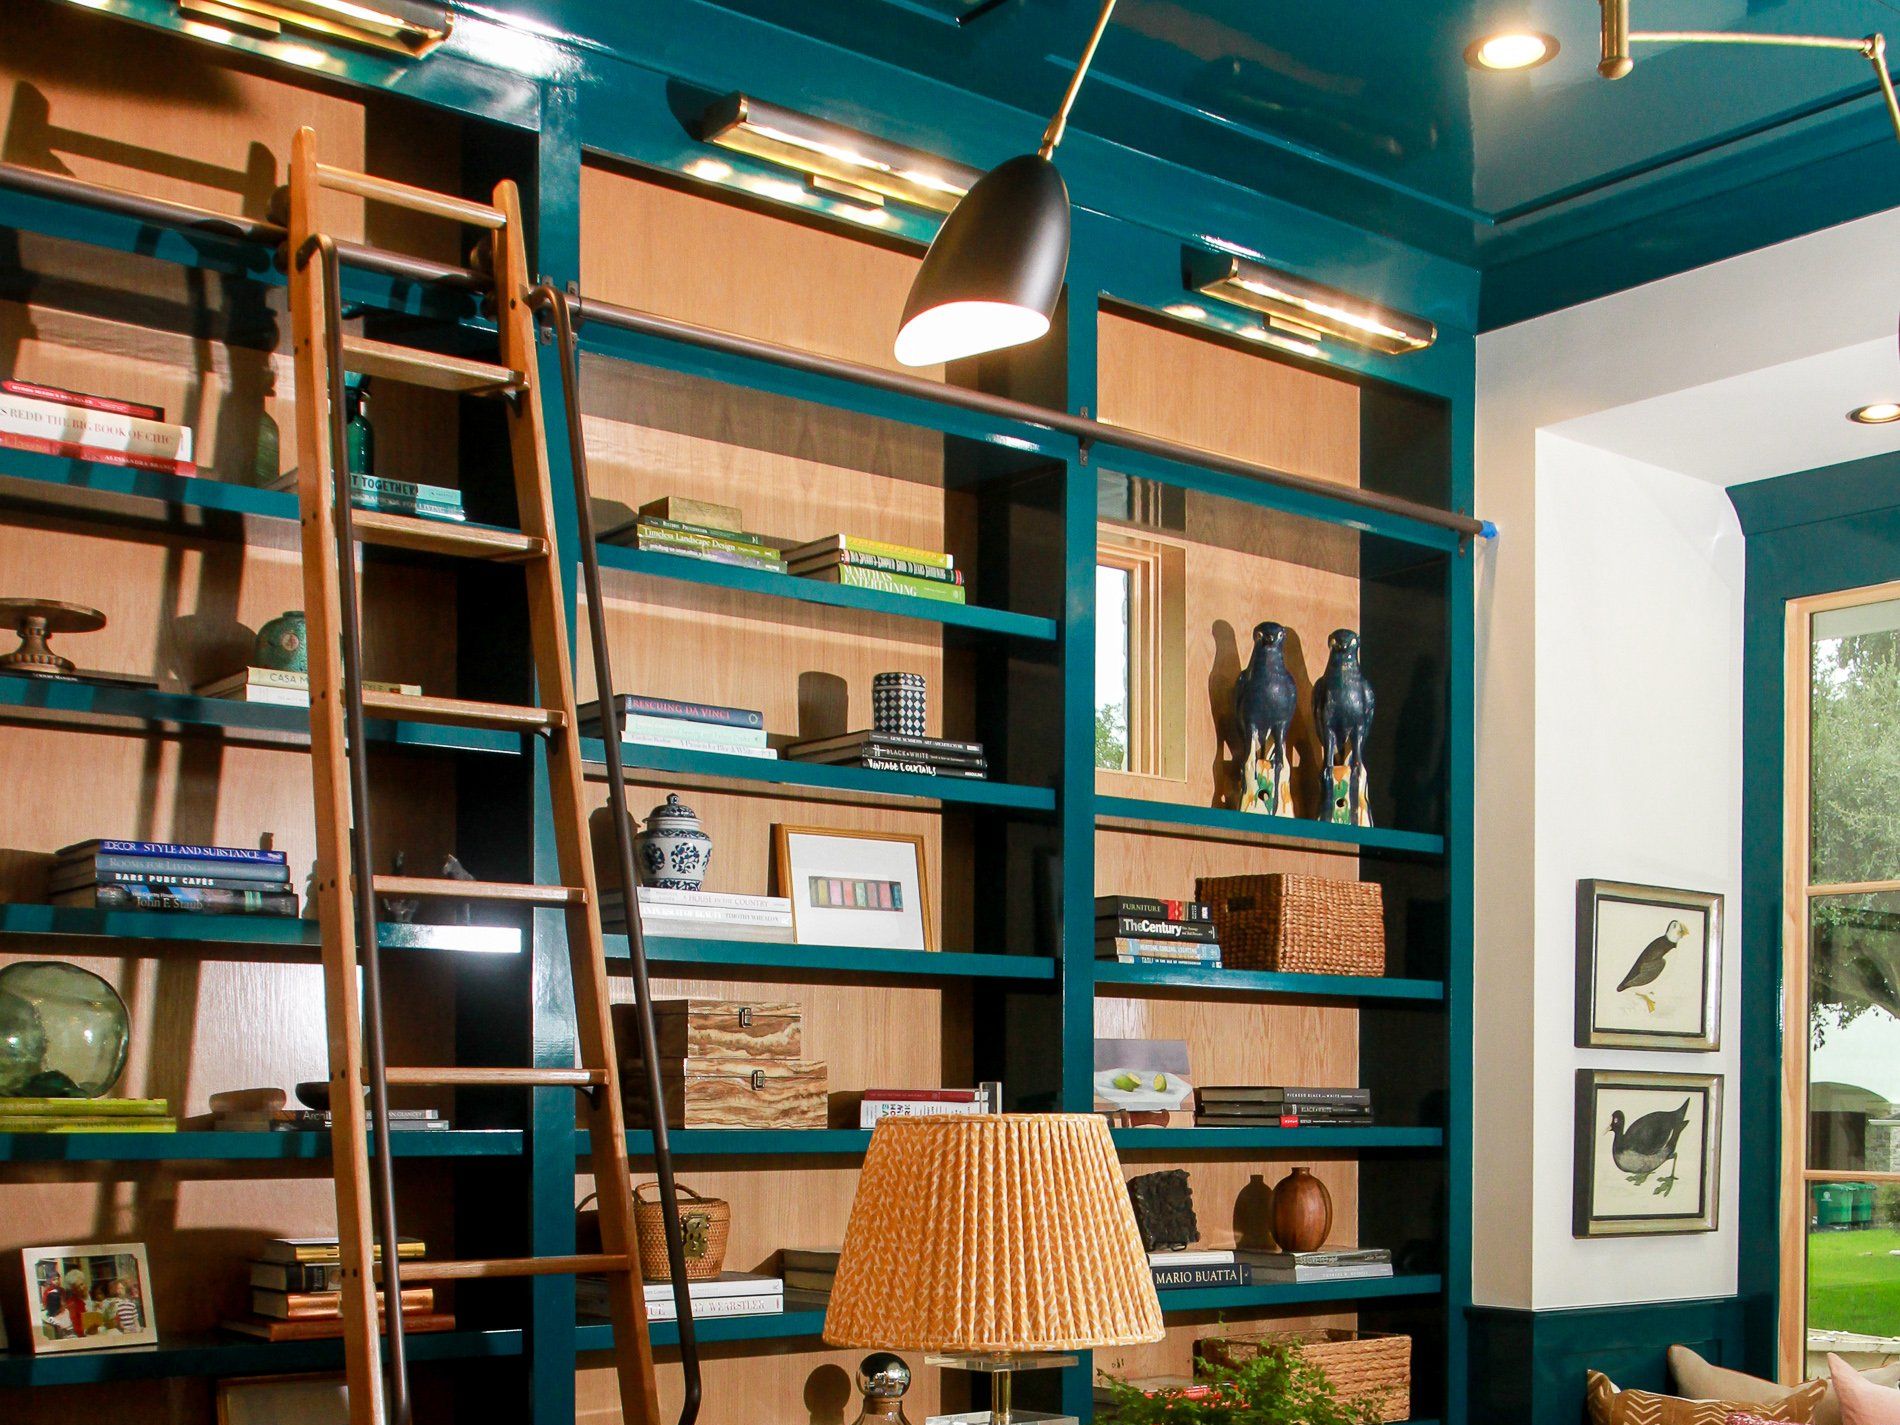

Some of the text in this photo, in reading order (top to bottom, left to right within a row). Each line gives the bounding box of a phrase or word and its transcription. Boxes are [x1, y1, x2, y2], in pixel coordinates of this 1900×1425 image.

[95, 424, 125, 436] BOOK
[643, 528, 736, 551] Timeless Landscape Design
[270, 673, 296, 683] CASA
[633, 700, 730, 719] RESCUING DA VINCI
[143, 844, 176, 854] STYLE
[179, 846, 201, 855] AND
[203, 847, 261, 859] SUBSTANCE
[115, 873, 143, 882] BARS
[149, 874, 176, 883] PUBS
[136, 896, 160, 908] John
[1122, 903, 1160, 912] FURNITURE
[1156, 1269, 1237, 1284] MARIO BUATTA
